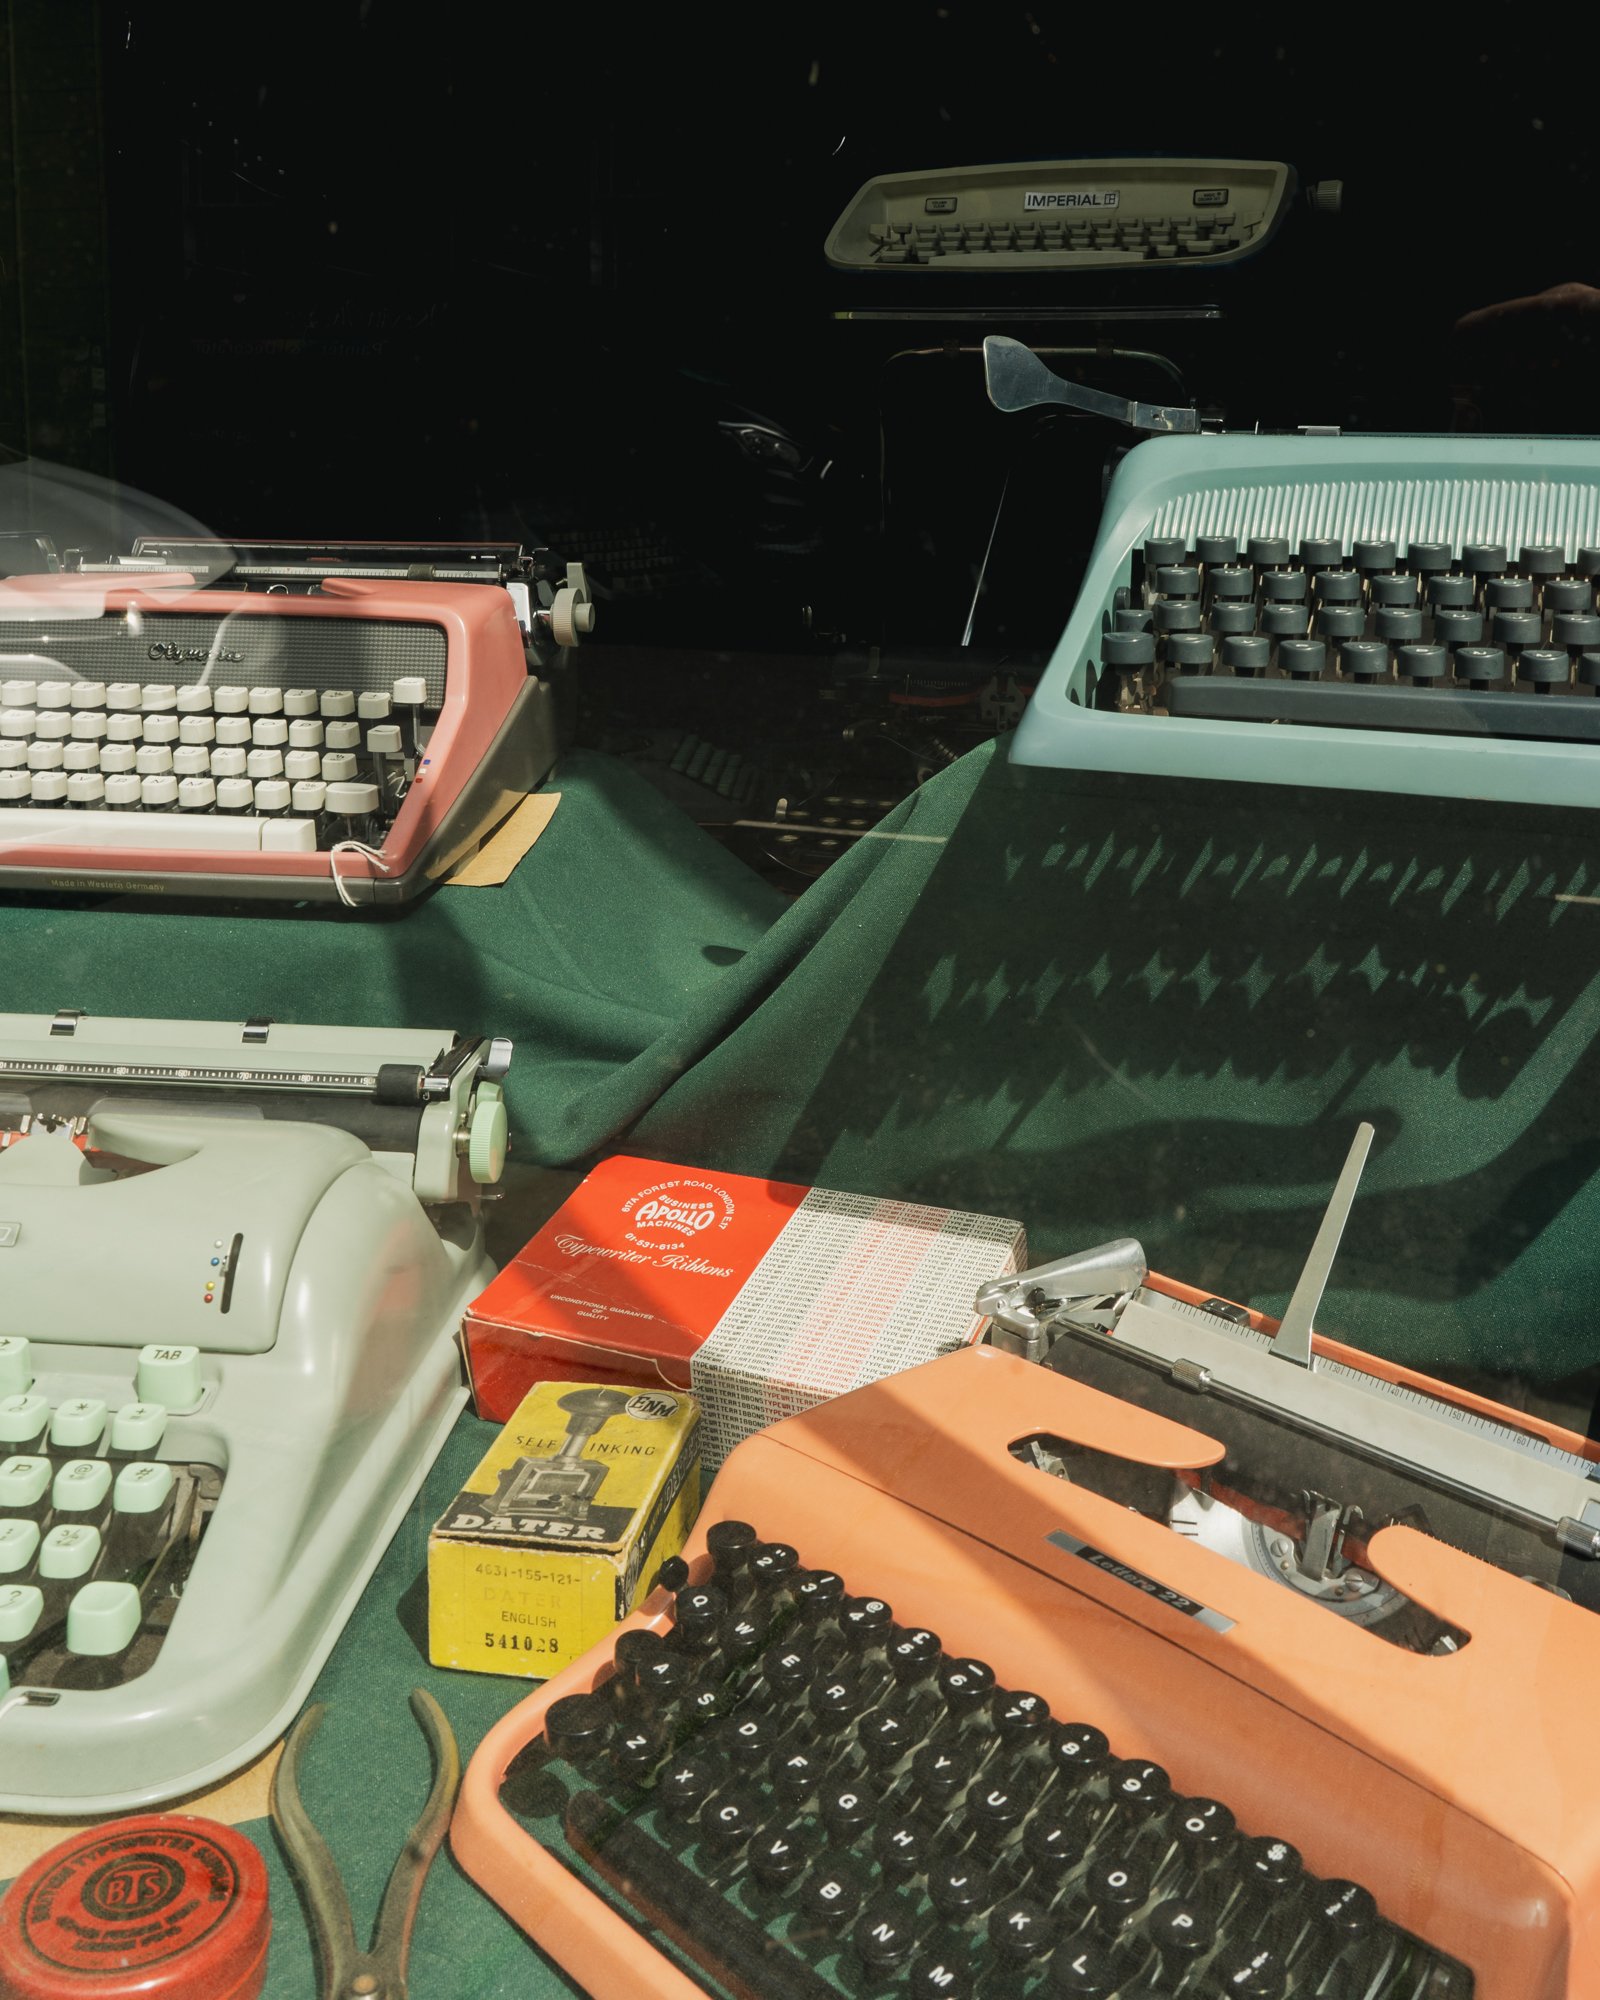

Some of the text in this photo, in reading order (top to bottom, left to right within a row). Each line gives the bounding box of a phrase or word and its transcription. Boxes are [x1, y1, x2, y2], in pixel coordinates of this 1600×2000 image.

[1027, 194, 1102, 207] IMPERIAL
[148, 641, 245, 665] Olymia
[87, 880, 123, 889] Western
[126, 881, 165, 891] Germany
[637, 1180, 680, 1198] FOREST
[713, 1187, 735, 1215] LONDON
[658, 1194, 714, 1210] BUSINESS
[635, 1200, 715, 1231] APOLLO
[636, 1220, 696, 1237] MACHINES
[554, 1233, 735, 1278] Typewriter Ribbons
[550, 1294, 655, 1320] UNCONDITIONAL GUARANTEE
[576, 1310, 610, 1321] QUALITY
[153, 1349, 183, 1361] TAB
[629, 1395, 678, 1418] ENM
[1390, 1387, 1400, 1397] 40
[1452, 1411, 1462, 1421] 50
[1516, 1435, 1526, 1446] 60
[515, 1435, 657, 1456] SELF INKING
[449, 1513, 606, 1541] DATER
[757, 1557, 773, 1566] 2
[801, 1583, 817, 1592] 3
[1088, 1554, 1191, 1609] Lettera 22
[693, 1595, 708, 1607] Q
[501, 1610, 557, 1629] ENGLISH
[849, 1613, 864, 1621] 4
[735, 1622, 754, 1634] W
[484, 1632, 559, 1654] 541028
[897, 1642, 915, 1654] 5
[782, 1655, 800, 1667] E
[653, 1664, 669, 1674] A
[950, 1674, 967, 1686] 6
[698, 1693, 715, 1705] S
[827, 1685, 845, 1699] R
[1005, 1707, 1022, 1717] 7
[739, 1723, 757, 1735] D
[881, 1719, 898, 1731] T
[626, 1735, 646, 1749] Z
[1062, 1742, 1080, 1755] 8
[788, 1756, 808, 1767] F
[935, 1756, 951, 1768] Y
[675, 1770, 693, 1783] X
[1122, 1779, 1141, 1791] 9
[839, 1794, 858, 1809] G
[987, 1791, 1007, 1806] U
[720, 1807, 738, 1820] C
[893, 1831, 913, 1846] H
[770, 1840, 788, 1854] V
[950, 1878, 967, 1886] J
[1108, 1871, 1127, 1887] O
[106, 1868, 162, 1905] BTS
[820, 1882, 841, 1899] B
[1009, 1912, 1031, 1930] K
[1172, 1914, 1193, 1927] P
[872, 1923, 895, 1942] N
[1072, 1955, 1087, 1974] L
[929, 1966, 954, 1986] M
